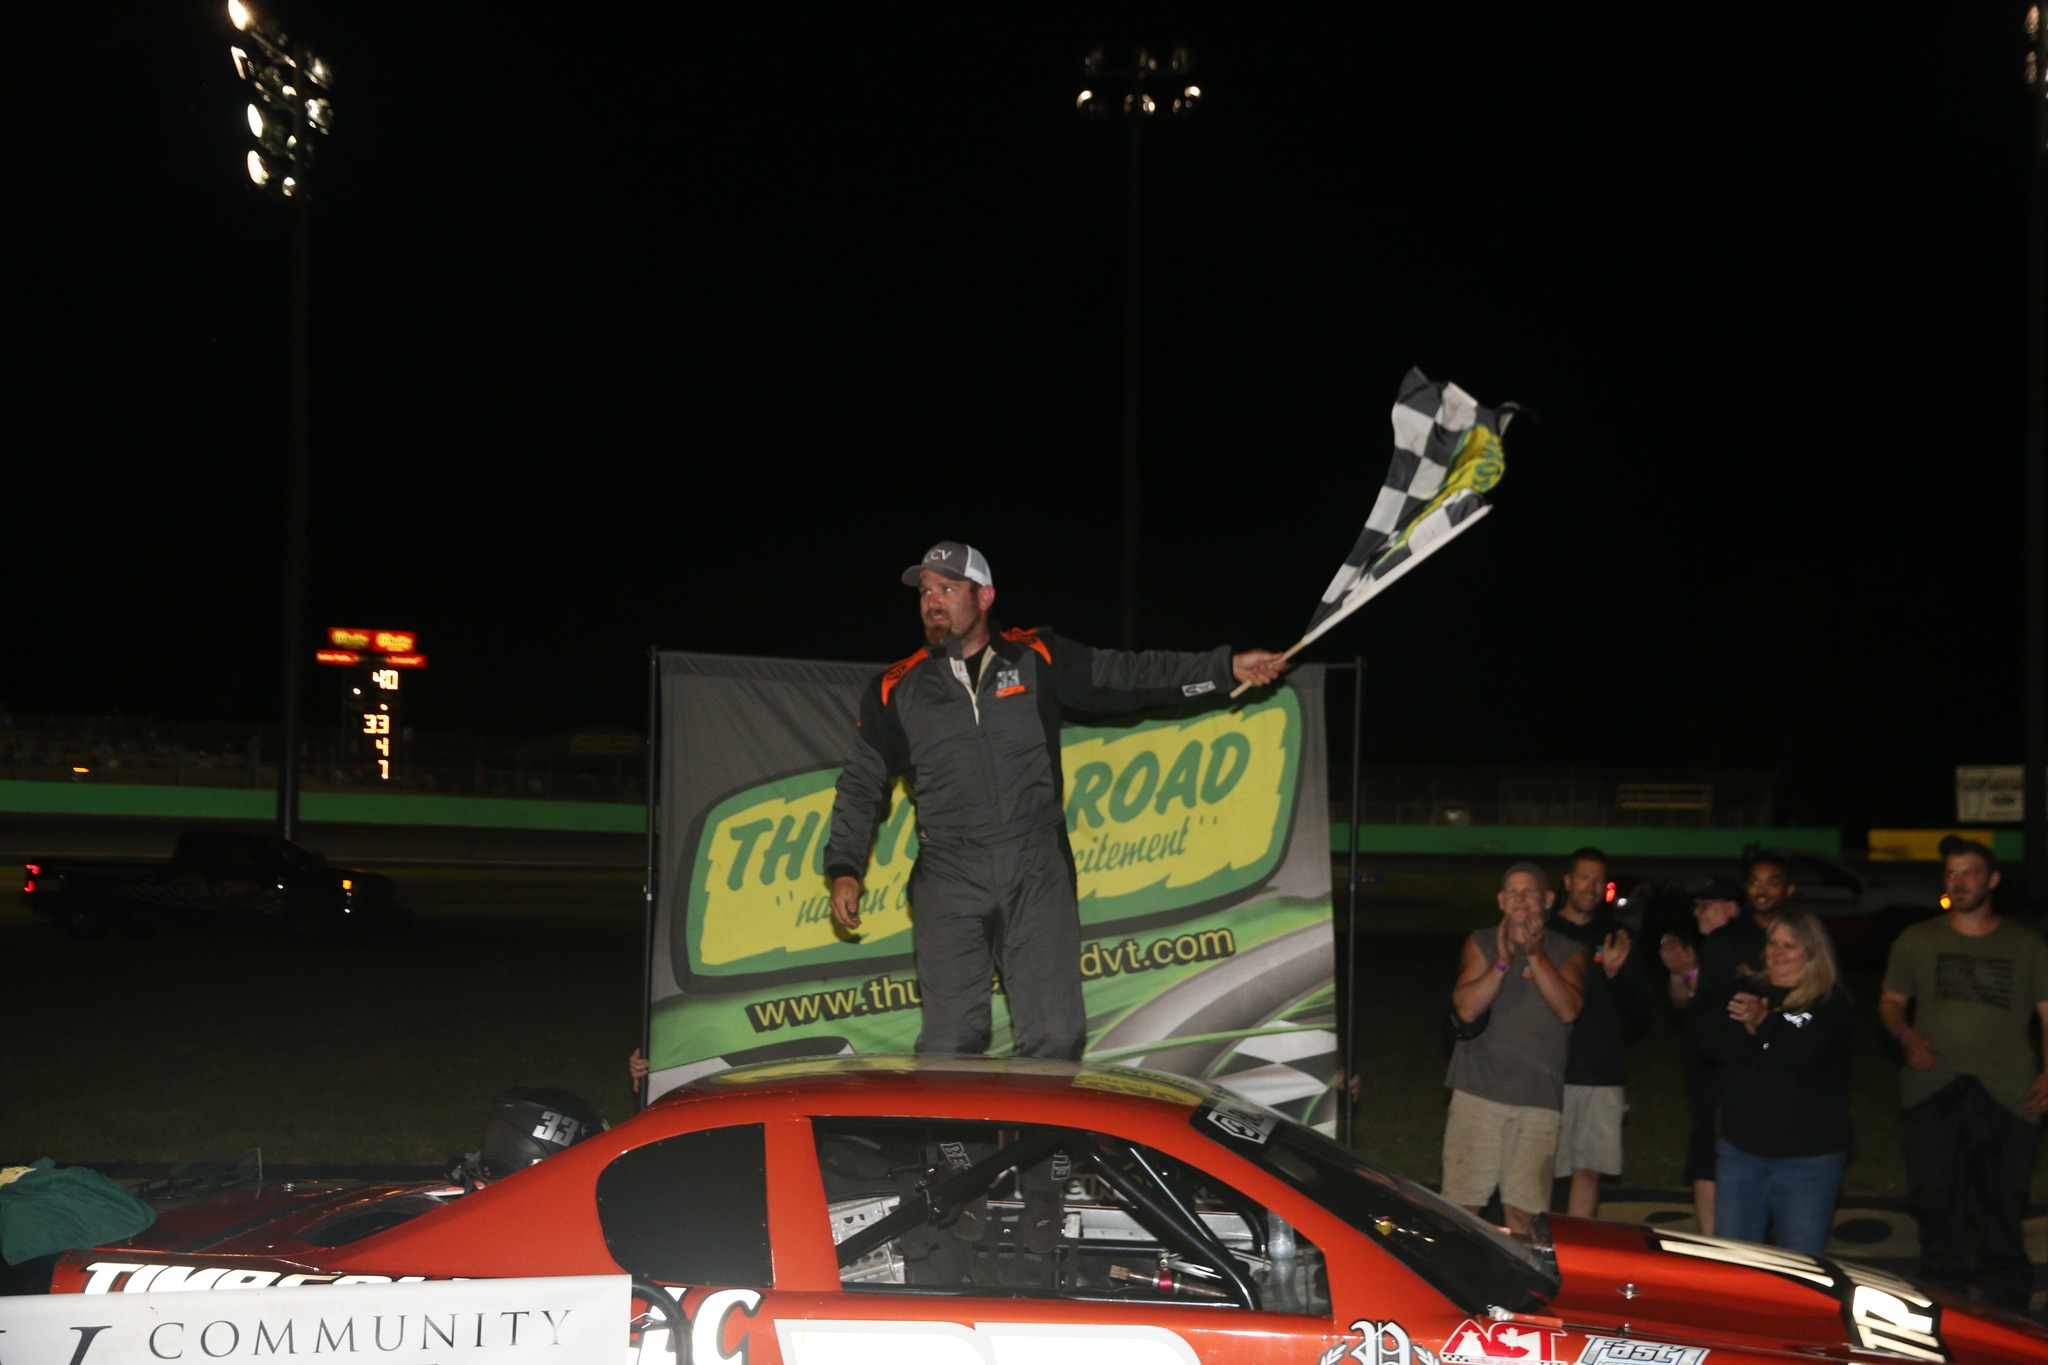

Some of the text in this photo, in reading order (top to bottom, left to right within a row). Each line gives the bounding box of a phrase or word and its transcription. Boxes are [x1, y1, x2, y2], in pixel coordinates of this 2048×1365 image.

[373, 670, 398, 690] 40
[364, 714, 389, 734] 33
[376, 737, 389, 756] 4
[1066, 731, 1250, 833] ROAD
[532, 1110, 580, 1148] 33
[149, 1310, 571, 1360] COMMUNITY
